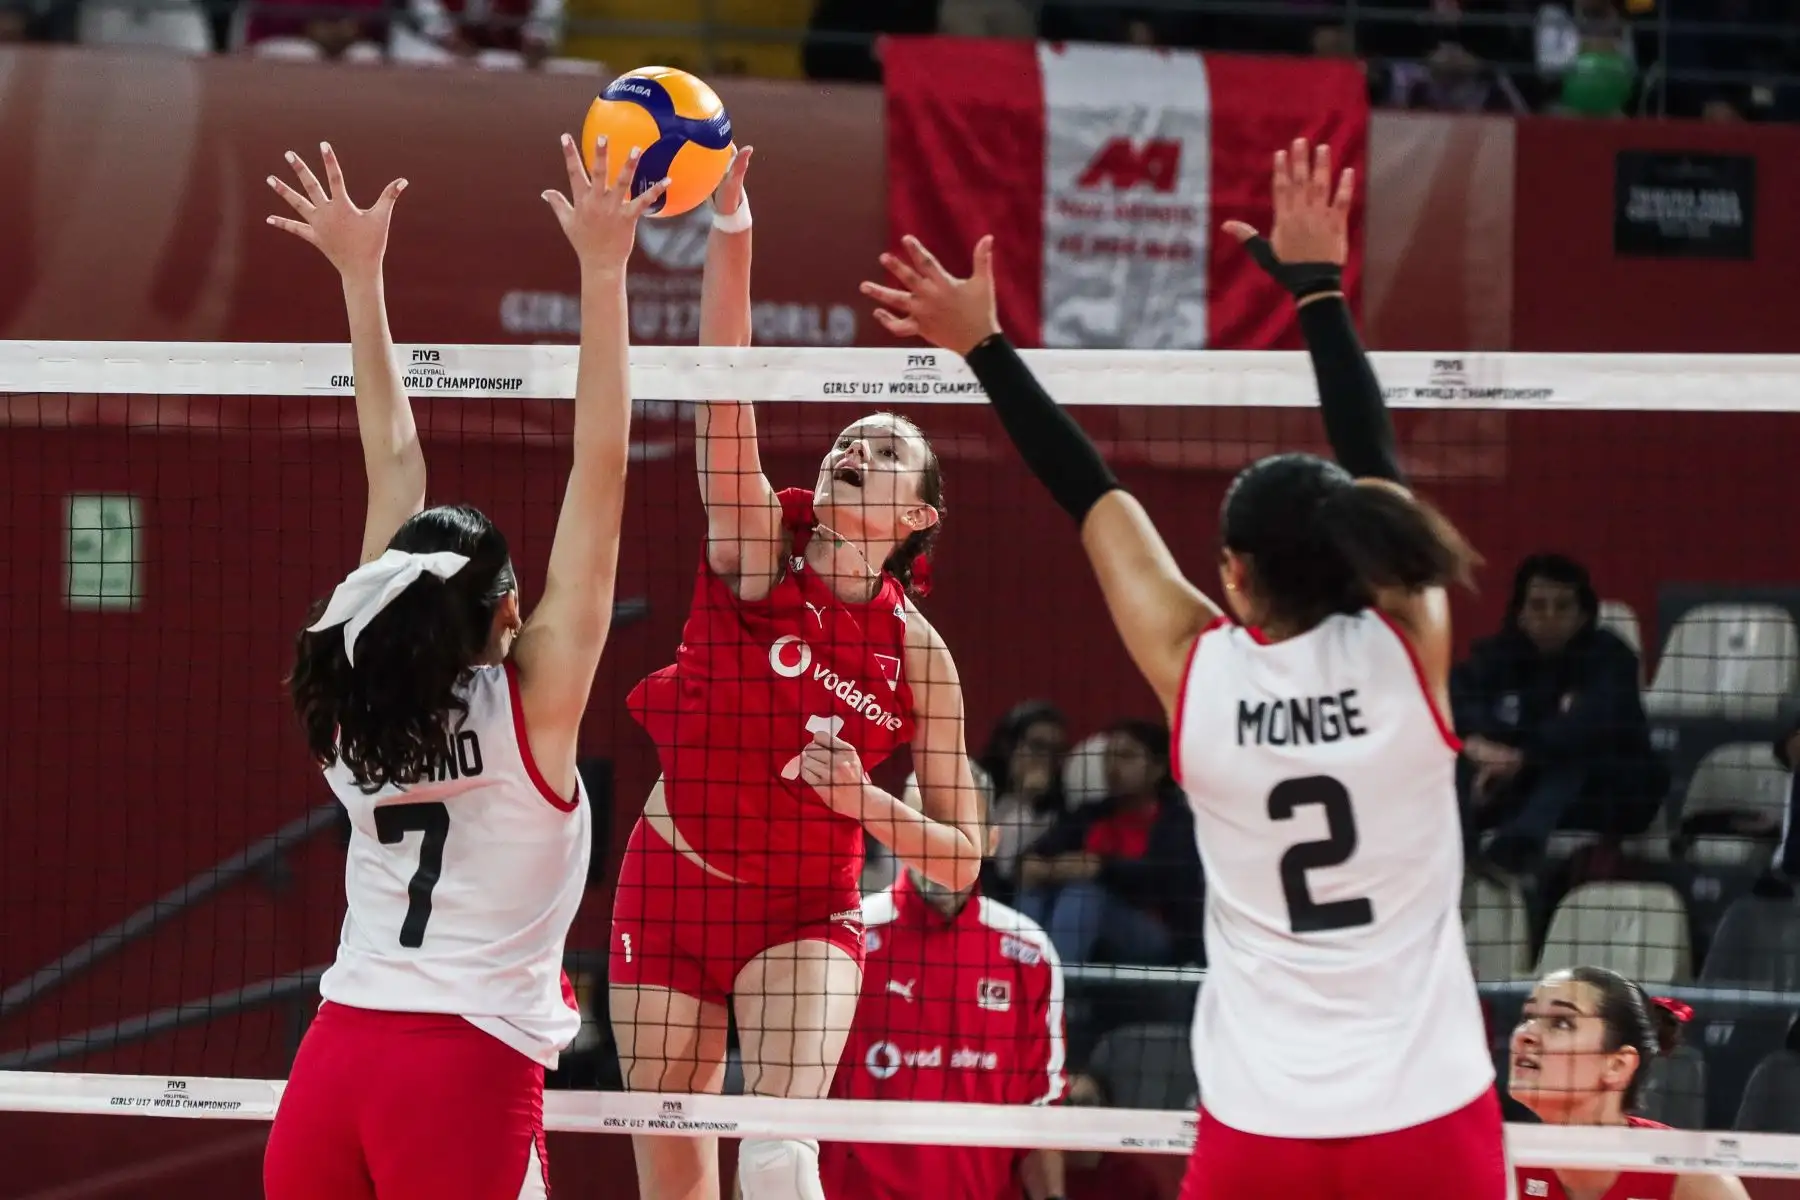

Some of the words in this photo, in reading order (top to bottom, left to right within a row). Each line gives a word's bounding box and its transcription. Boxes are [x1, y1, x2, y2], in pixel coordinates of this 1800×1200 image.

[500, 291, 581, 332] GIRL
[750, 302, 857, 343] ORLD
[412, 350, 440, 361] FIVB
[907, 355, 936, 366] FIVB
[408, 368, 446, 376] VOLLEYBALL
[330, 375, 355, 387] GIRL
[401, 376, 433, 388] ORLD
[436, 377, 523, 390] CHAMPIONSHIP
[823, 382, 860, 394] GIRLS'
[862, 383, 884, 394] U17
[889, 382, 930, 394] WORLD
[813, 662, 903, 731] vodafone
[1237, 689, 1368, 746] MONGE
[1267, 775, 1374, 933] 2
[374, 802, 450, 948] 7
[167, 1080, 187, 1089] FIVB
[136, 1098, 151, 1106] U17
[153, 1099, 180, 1108] WORLD
[182, 1099, 242, 1110] CHAMPIONSHIP
[648, 1119, 676, 1129] WORLD
[677, 1121, 739, 1131] CHAMPIONSHIP
